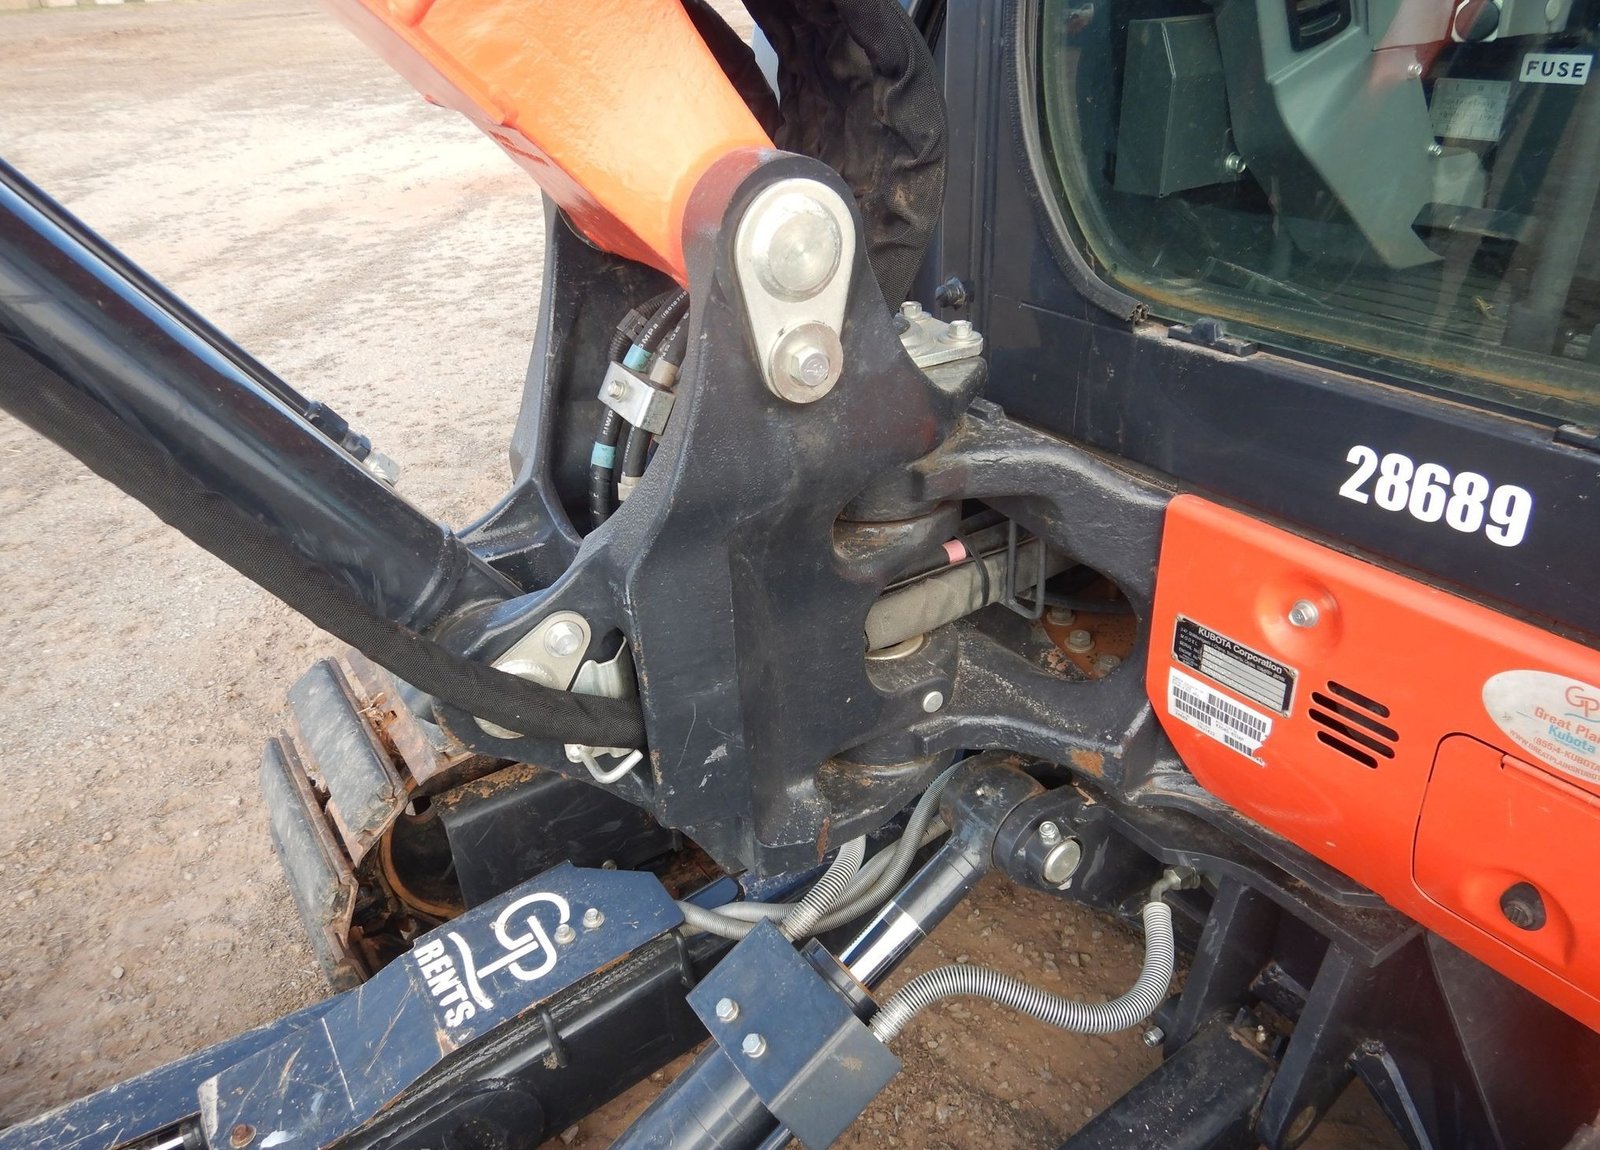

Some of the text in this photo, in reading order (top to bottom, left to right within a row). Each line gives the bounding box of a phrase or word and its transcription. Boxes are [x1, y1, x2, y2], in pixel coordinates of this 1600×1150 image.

[1526, 60, 1586, 78] FUSE
[1338, 444, 1533, 547] 28689
[1198, 627, 1232, 650] KUBOTA
[1233, 645, 1283, 674] Corporation
[1534, 706, 1572, 731] Great
[1548, 724, 1596, 754] Kubota
[413, 938, 476, 1028] RENTS
